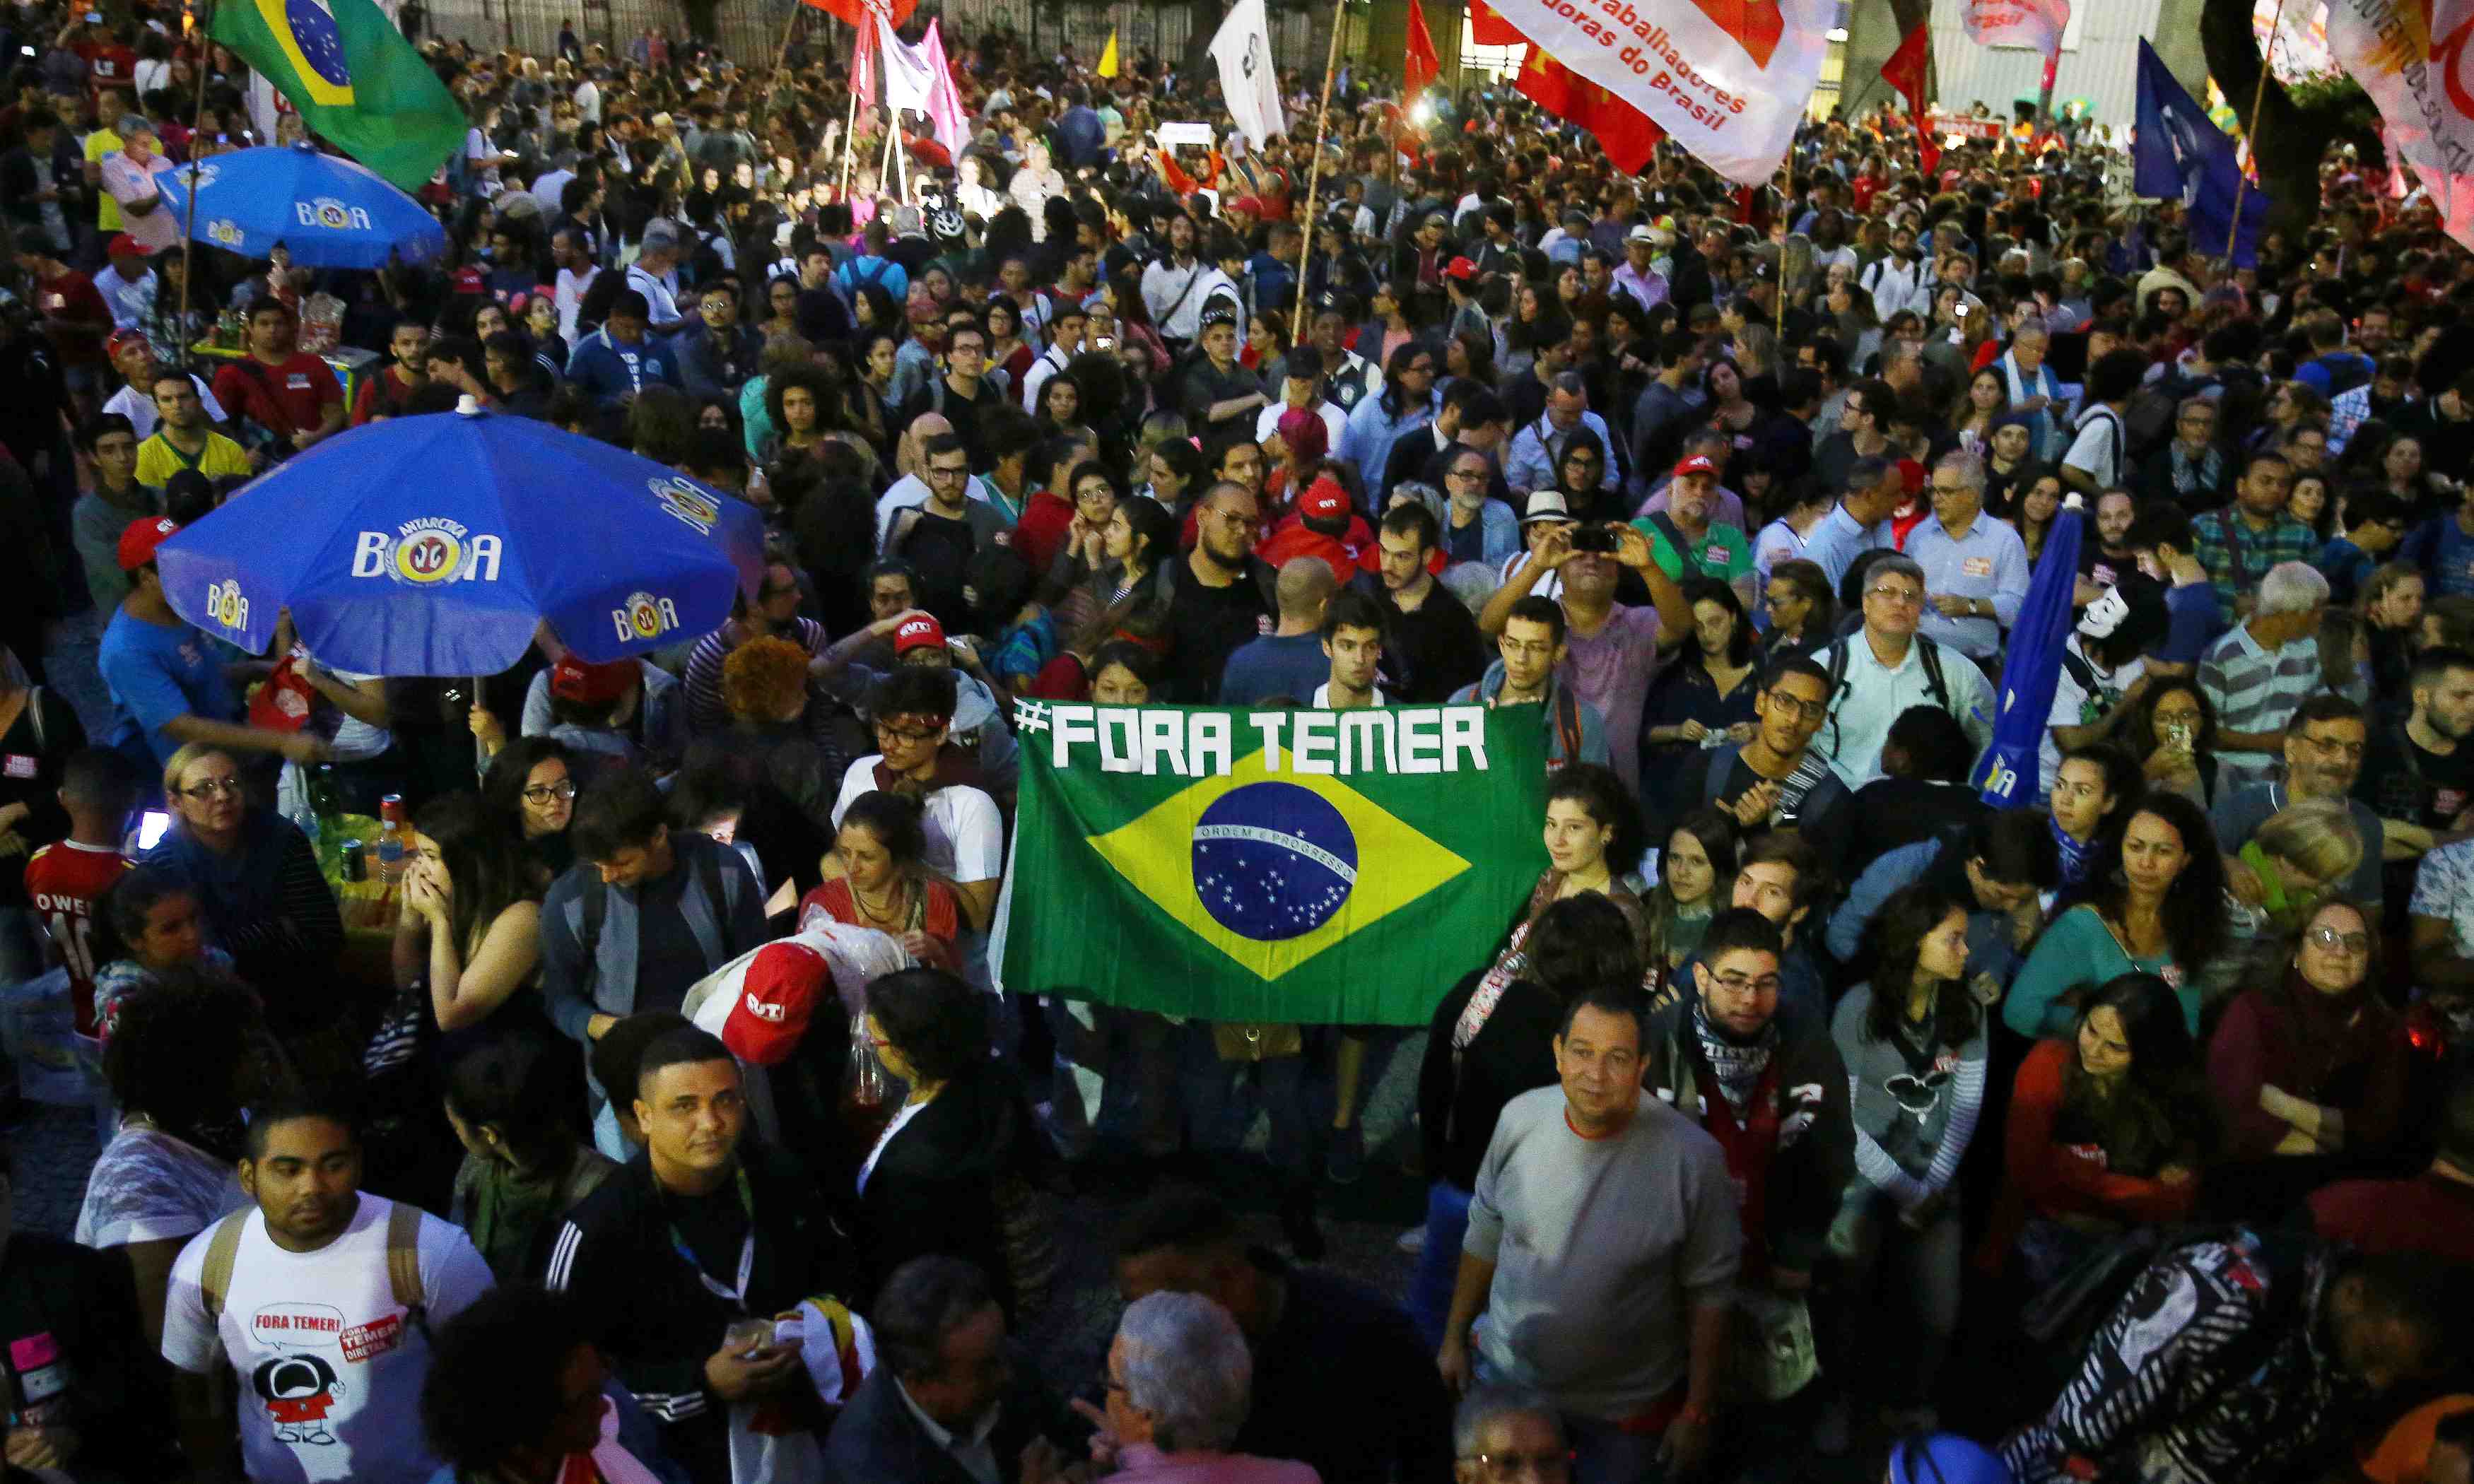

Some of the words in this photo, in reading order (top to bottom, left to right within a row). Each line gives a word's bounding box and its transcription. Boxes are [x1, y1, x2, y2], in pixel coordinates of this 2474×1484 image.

[1619, 45, 1649, 74] do
[1649, 70, 1728, 131] Brasil
[295, 201, 372, 230] BOA
[351, 531, 503, 585] BOA
[207, 582, 250, 632] BOA
[611, 597, 679, 642] BOA
[1249, 705, 1489, 776] TEMER
[1201, 824, 1252, 837] ORDEM
[1272, 832, 1352, 878] PROGRESSO
[256, 1314, 290, 1329] FORA
[293, 1315, 340, 1332] TEMER!
[340, 1322, 400, 1348] TEMER
